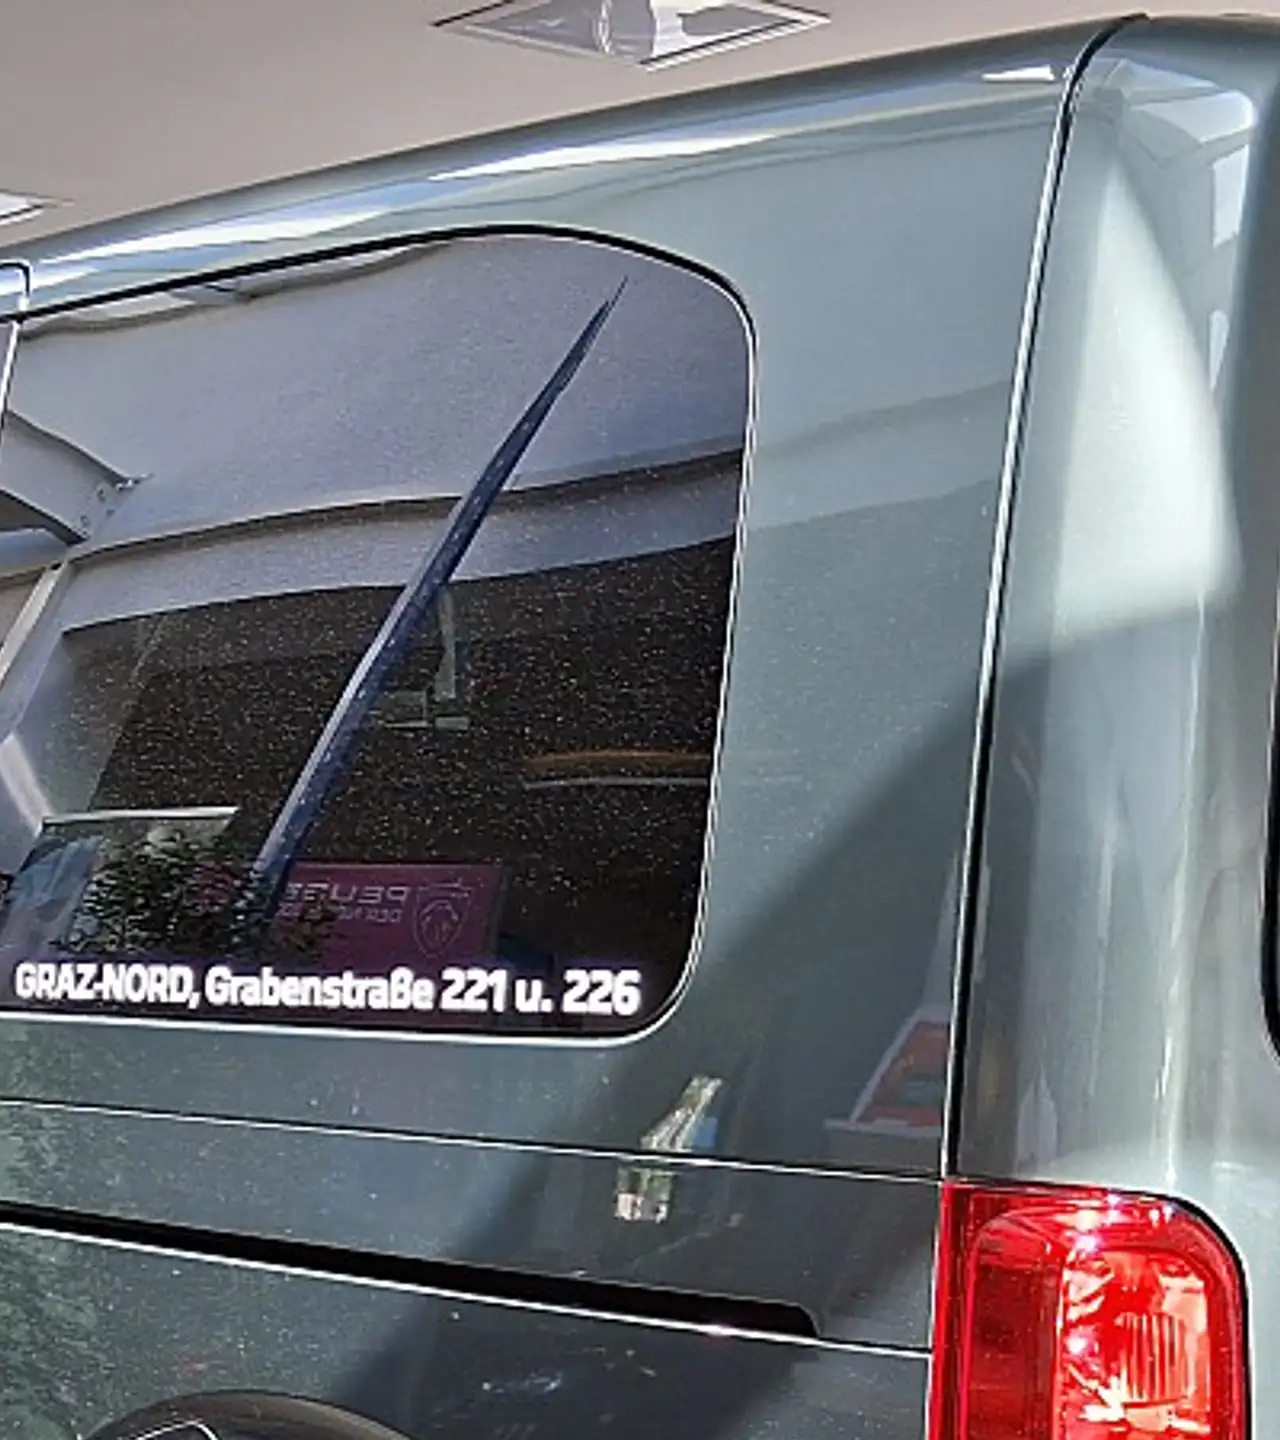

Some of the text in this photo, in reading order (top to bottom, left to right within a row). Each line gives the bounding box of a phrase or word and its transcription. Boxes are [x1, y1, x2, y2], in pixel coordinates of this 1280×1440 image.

[15, 963, 642, 1016] GRAZ-NORD, Grabenstraße 221 u. 226
